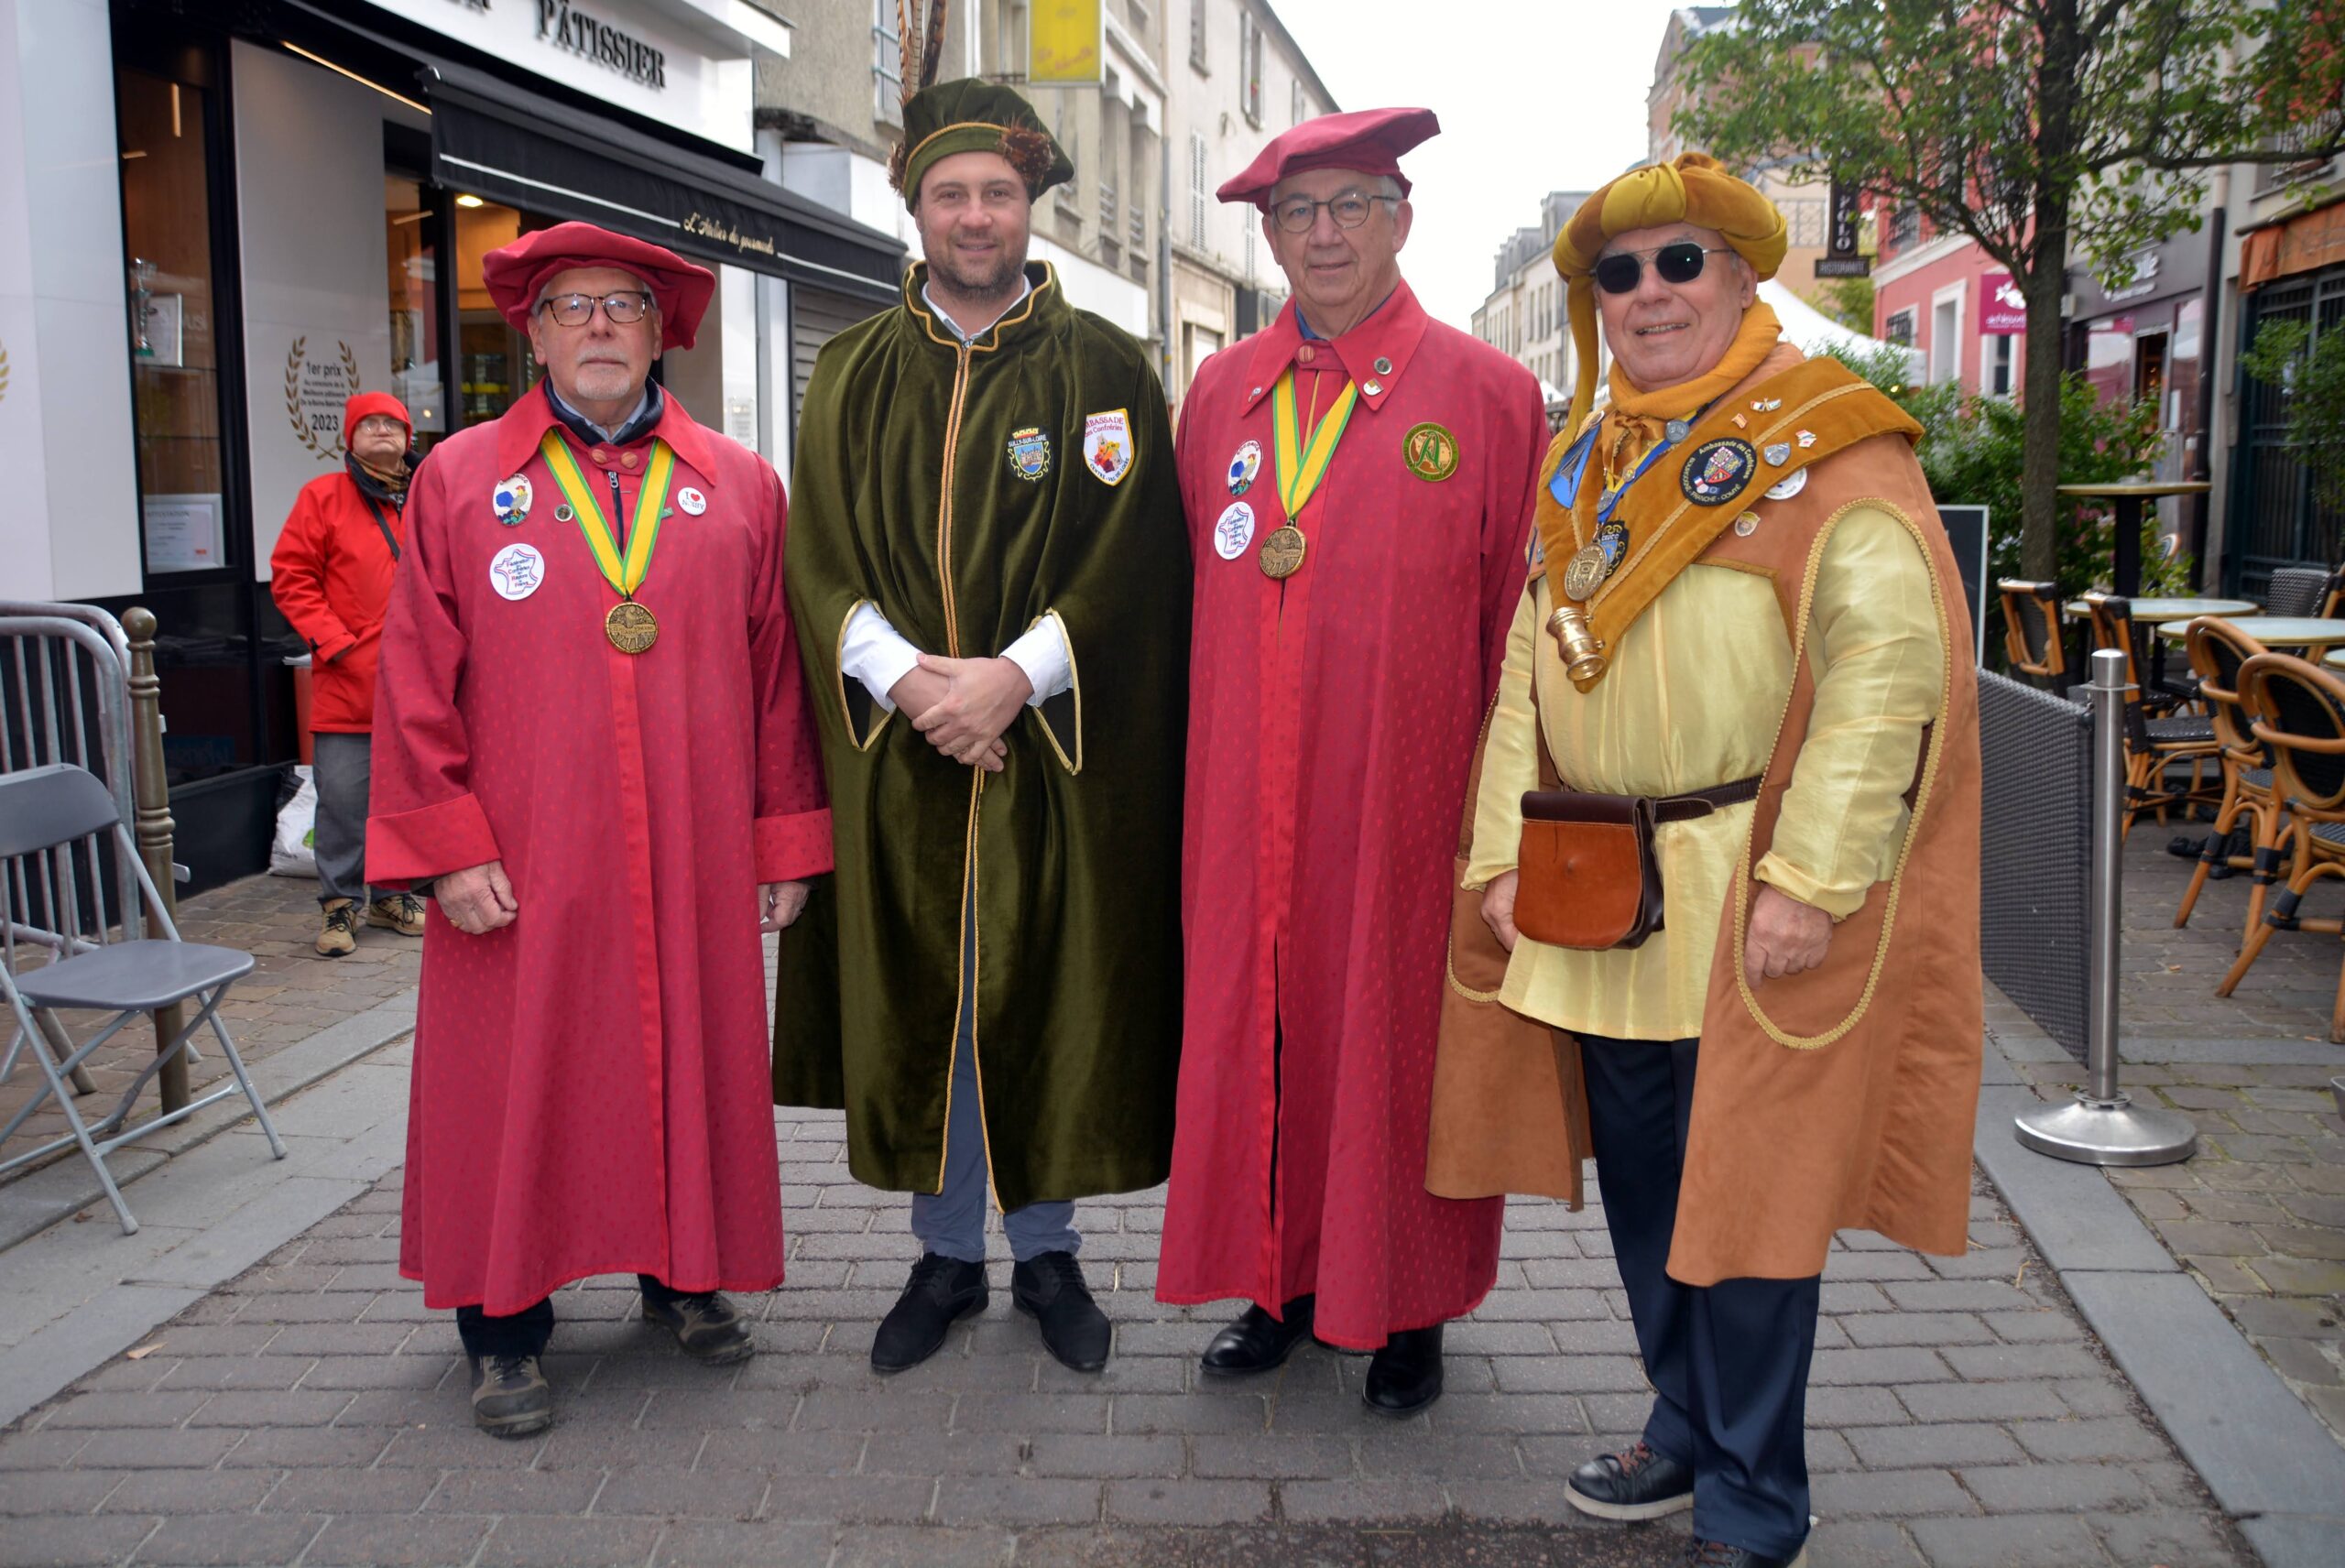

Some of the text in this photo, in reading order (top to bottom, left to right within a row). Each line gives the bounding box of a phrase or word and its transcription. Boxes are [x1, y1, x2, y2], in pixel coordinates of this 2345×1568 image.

[536, 0, 667, 89] PÂTISSIER
[306, 360, 342, 379] 1er prix
[311, 414, 339, 431] 2023
[1085, 417, 1124, 429] MBASSADE
[1008, 433, 1047, 448] SULLY-SUR-LOIRE
[1699, 441, 1738, 454] Ambassade
